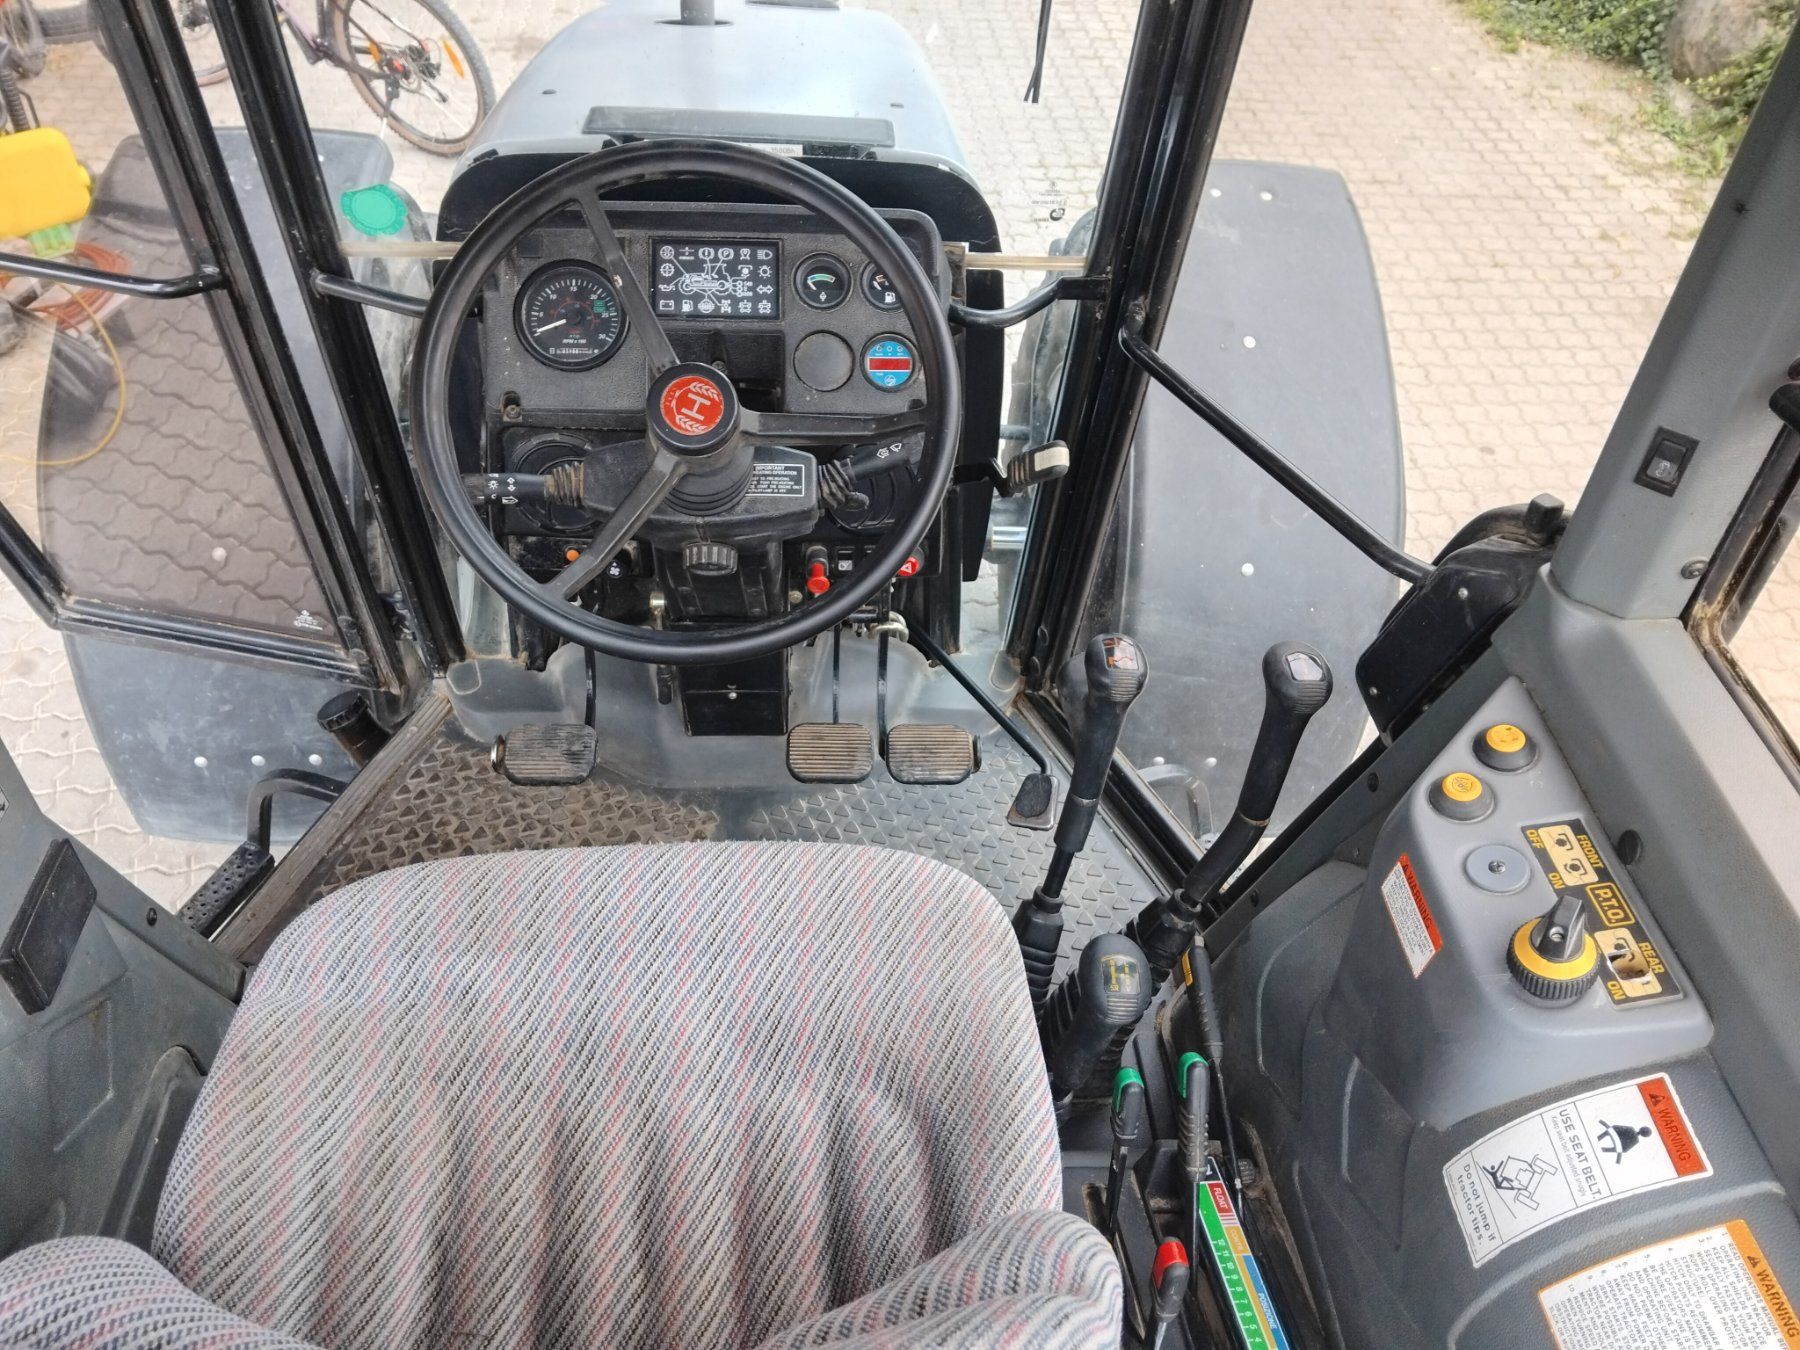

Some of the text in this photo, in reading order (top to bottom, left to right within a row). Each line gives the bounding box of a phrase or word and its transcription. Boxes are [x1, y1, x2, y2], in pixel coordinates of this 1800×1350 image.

[1525, 829, 1544, 848] OFF
[1577, 834, 1603, 867] FRONT
[1405, 872, 1432, 927] WARNING
[1548, 873, 1564, 887] ON
[1594, 888, 1624, 920] P.T.O.
[1638, 942, 1664, 973] REAR
[1605, 981, 1625, 999] ON
[1558, 1108, 1602, 1199] USE SEAT BELT.
[1657, 1107, 1691, 1162] WARNING
[1212, 1187, 1228, 1208] FLOAT
[1456, 1174, 1475, 1216] tractor
[1470, 1216, 1485, 1245] tips.
[1463, 1163, 1496, 1241] Do not jump if
[1597, 1282, 1612, 1305] JERKY
[1657, 1263, 1667, 1275] THE
[1663, 1277, 1687, 1317] OPERATORS
[1663, 1260, 1679, 1280] HITCH
[1674, 1282, 1692, 1306] POINTS
[1671, 1258, 1686, 1277] HITCH
[1682, 1280, 1696, 1296] ONLY
[1687, 1254, 1701, 1271] ROPS
[1708, 1296, 1723, 1314] OVER
[1711, 1247, 1725, 1264] KEEP
[1720, 1266, 1731, 1278] ALL
[1728, 1281, 1748, 1309] SHIELDS
[1719, 1245, 1743, 1282] OPERATING
[1740, 1286, 1753, 1300] THIS
[1727, 1243, 1741, 1260] READ
[1737, 1262, 1763, 1303] OPERATORS
[1759, 1305, 1780, 1335] MANUAL
[1257, 1293, 1278, 1328] POSIZIONE
[1584, 1288, 1611, 1340] TRACTOR NEAR
[1591, 1285, 1606, 1308] WHERE
[1601, 1309, 1621, 1343] POSSIBLE
[1604, 1279, 1623, 1311] OPERATE
[1619, 1311, 1638, 1344] TRACTOR
[1612, 1278, 1647, 1343] AWAY FROM POWER
[1618, 1274, 1632, 1292] KEEP
[1640, 1321, 1653, 1338] FEET
[1625, 1271, 1635, 1281] DO
[1631, 1283, 1643, 1298] NOT
[1638, 1299, 1655, 1325] PERMIT
[1633, 1269, 1645, 1284] AND
[1641, 1285, 1664, 1323] OPERATING
[1641, 1267, 1660, 1297] MACHINE
[1656, 1299, 1674, 1326] BEFORE
[1648, 1264, 1658, 1273] BE
[1653, 1275, 1667, 1293] SURE
[1663, 1294, 1678, 1316] EVERY
[1674, 1318, 1686, 1334] ONE
[1692, 1300, 1702, 1308] TO
[1695, 1252, 1749, 1347] WHEN OPERATING TRACTOR
[1703, 1249, 1725, 1282] SECURELY
[1721, 1285, 1740, 1311] FASTEN
[1736, 1314, 1750, 1333] YOUR
[1747, 1335, 1761, 1350] SEA
[1755, 1270, 1800, 1337] WARNING
[1696, 1311, 1721, 1346] DRAWBAR
